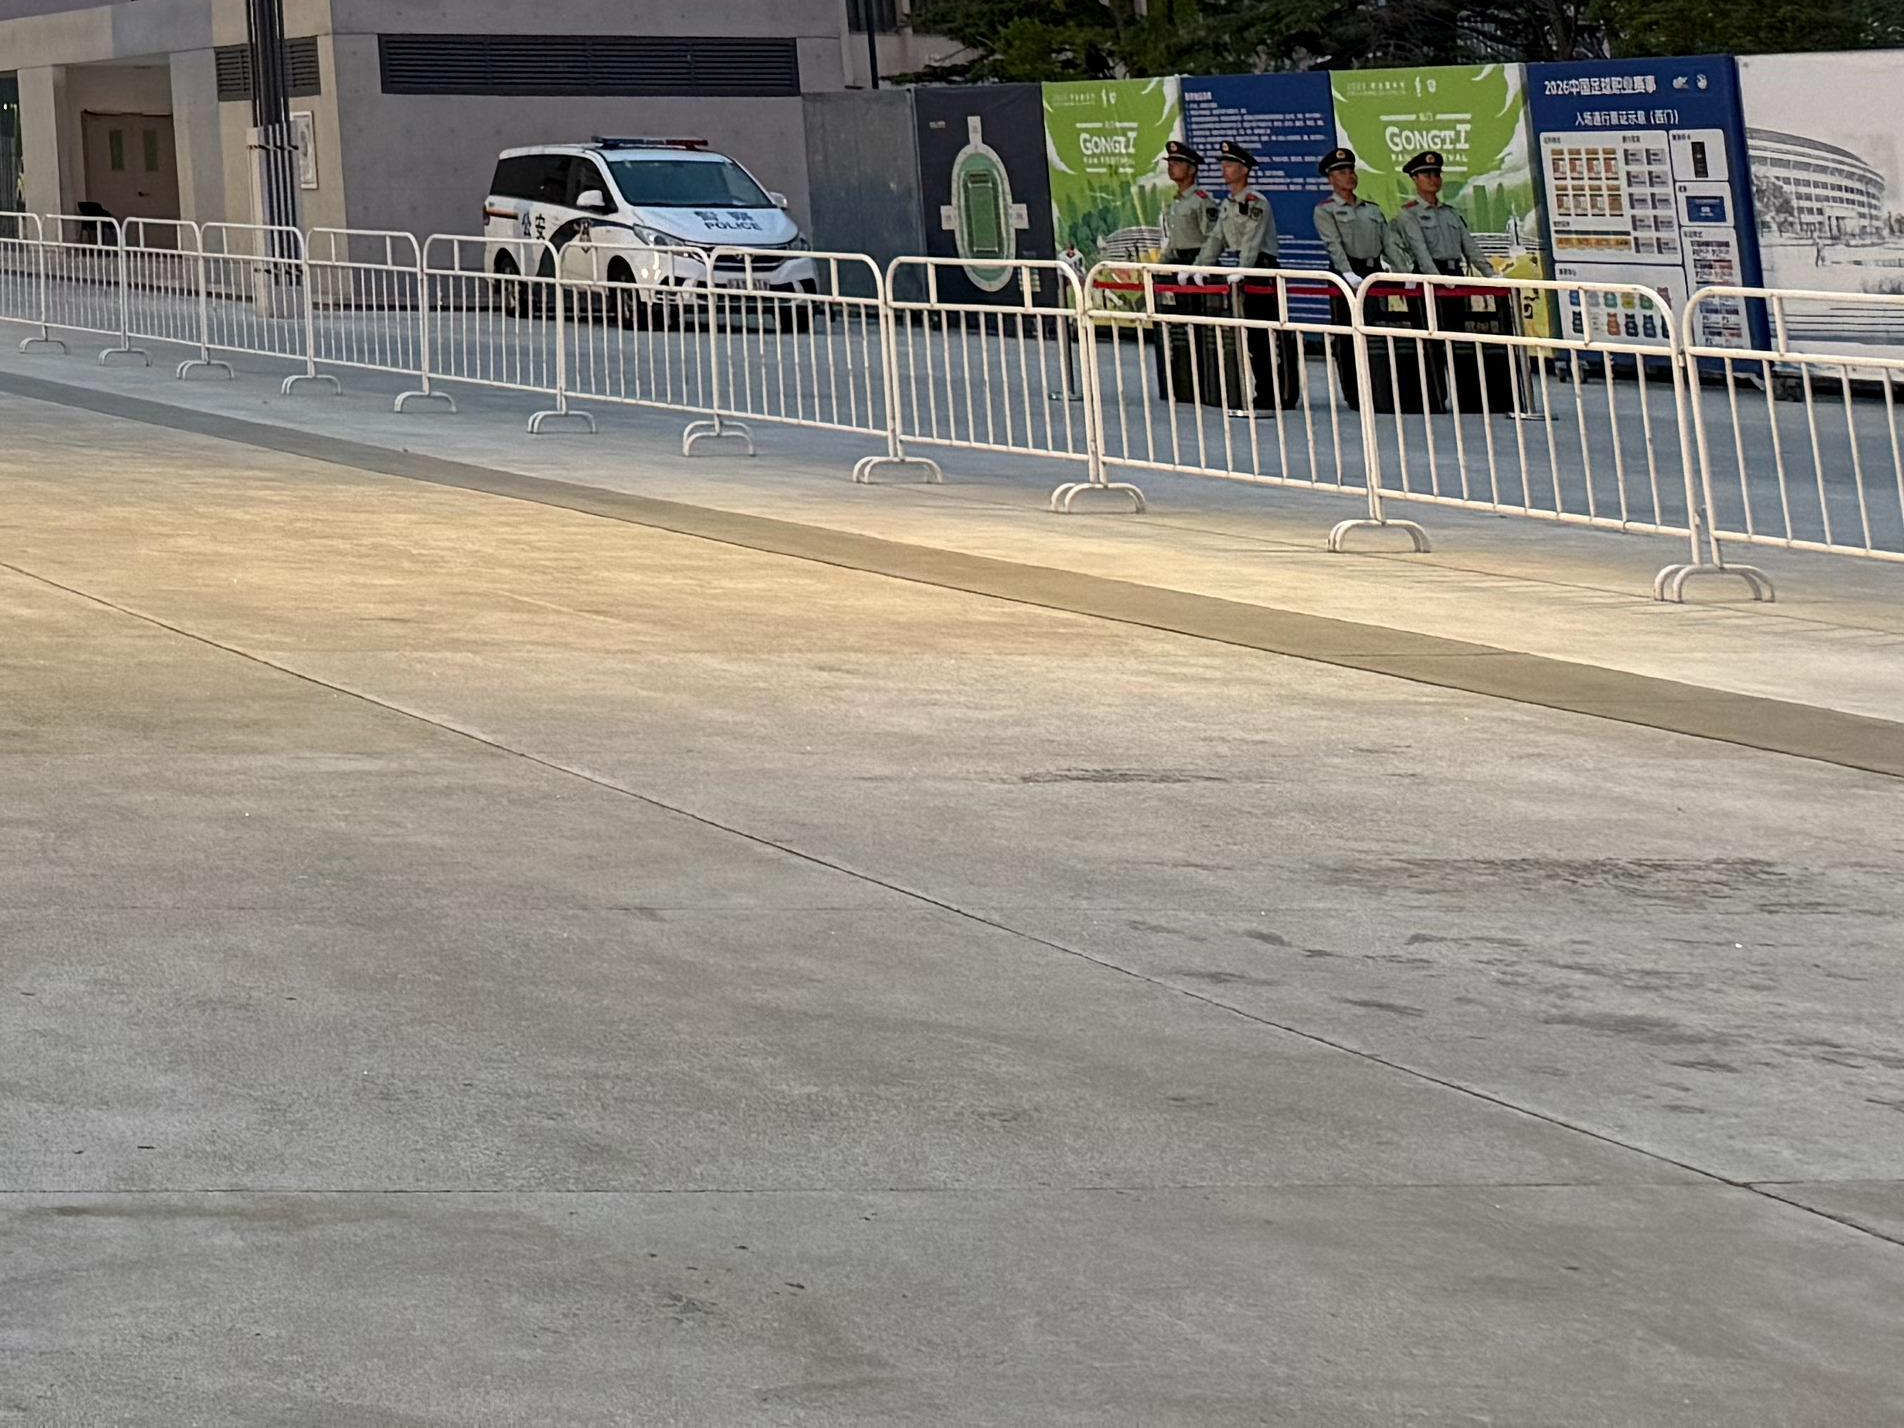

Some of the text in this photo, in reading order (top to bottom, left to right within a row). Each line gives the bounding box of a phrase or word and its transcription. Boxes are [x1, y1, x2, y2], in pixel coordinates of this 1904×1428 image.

[1080, 131, 1138, 155] GONGTI
[1385, 123, 1471, 152] GONGTI
[522, 211, 545, 240] 公安
[694, 211, 754, 221] 警察
[704, 222, 763, 231] POLICE
